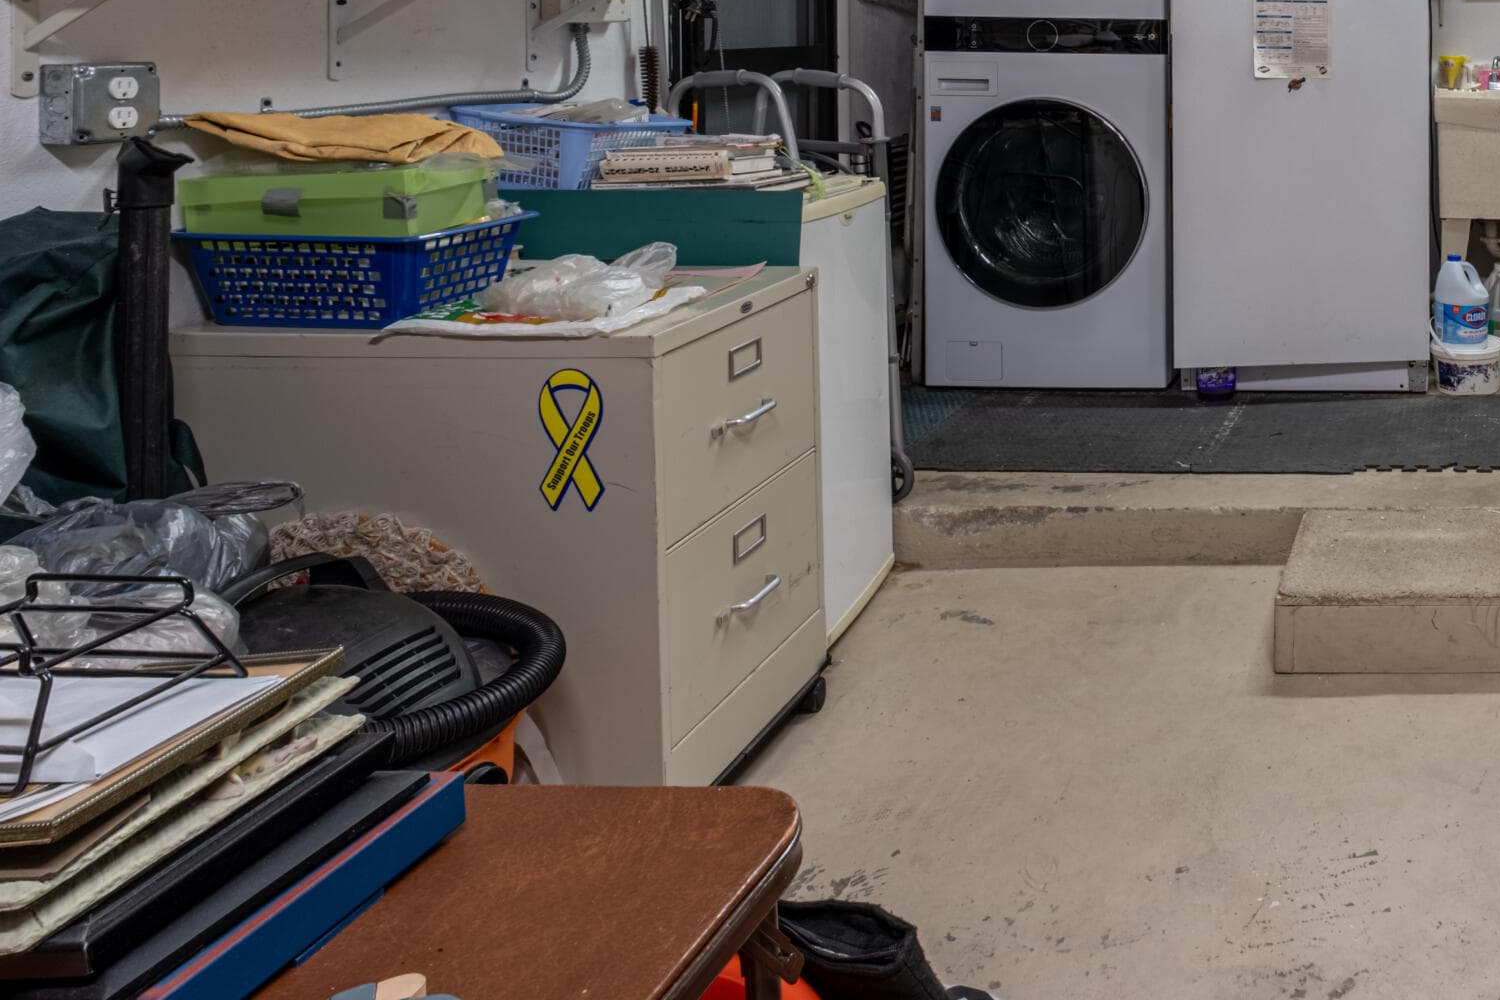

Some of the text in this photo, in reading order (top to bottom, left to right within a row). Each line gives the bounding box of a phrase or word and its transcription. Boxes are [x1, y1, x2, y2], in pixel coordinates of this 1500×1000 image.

[547, 411, 596, 490] Support Our Troops
